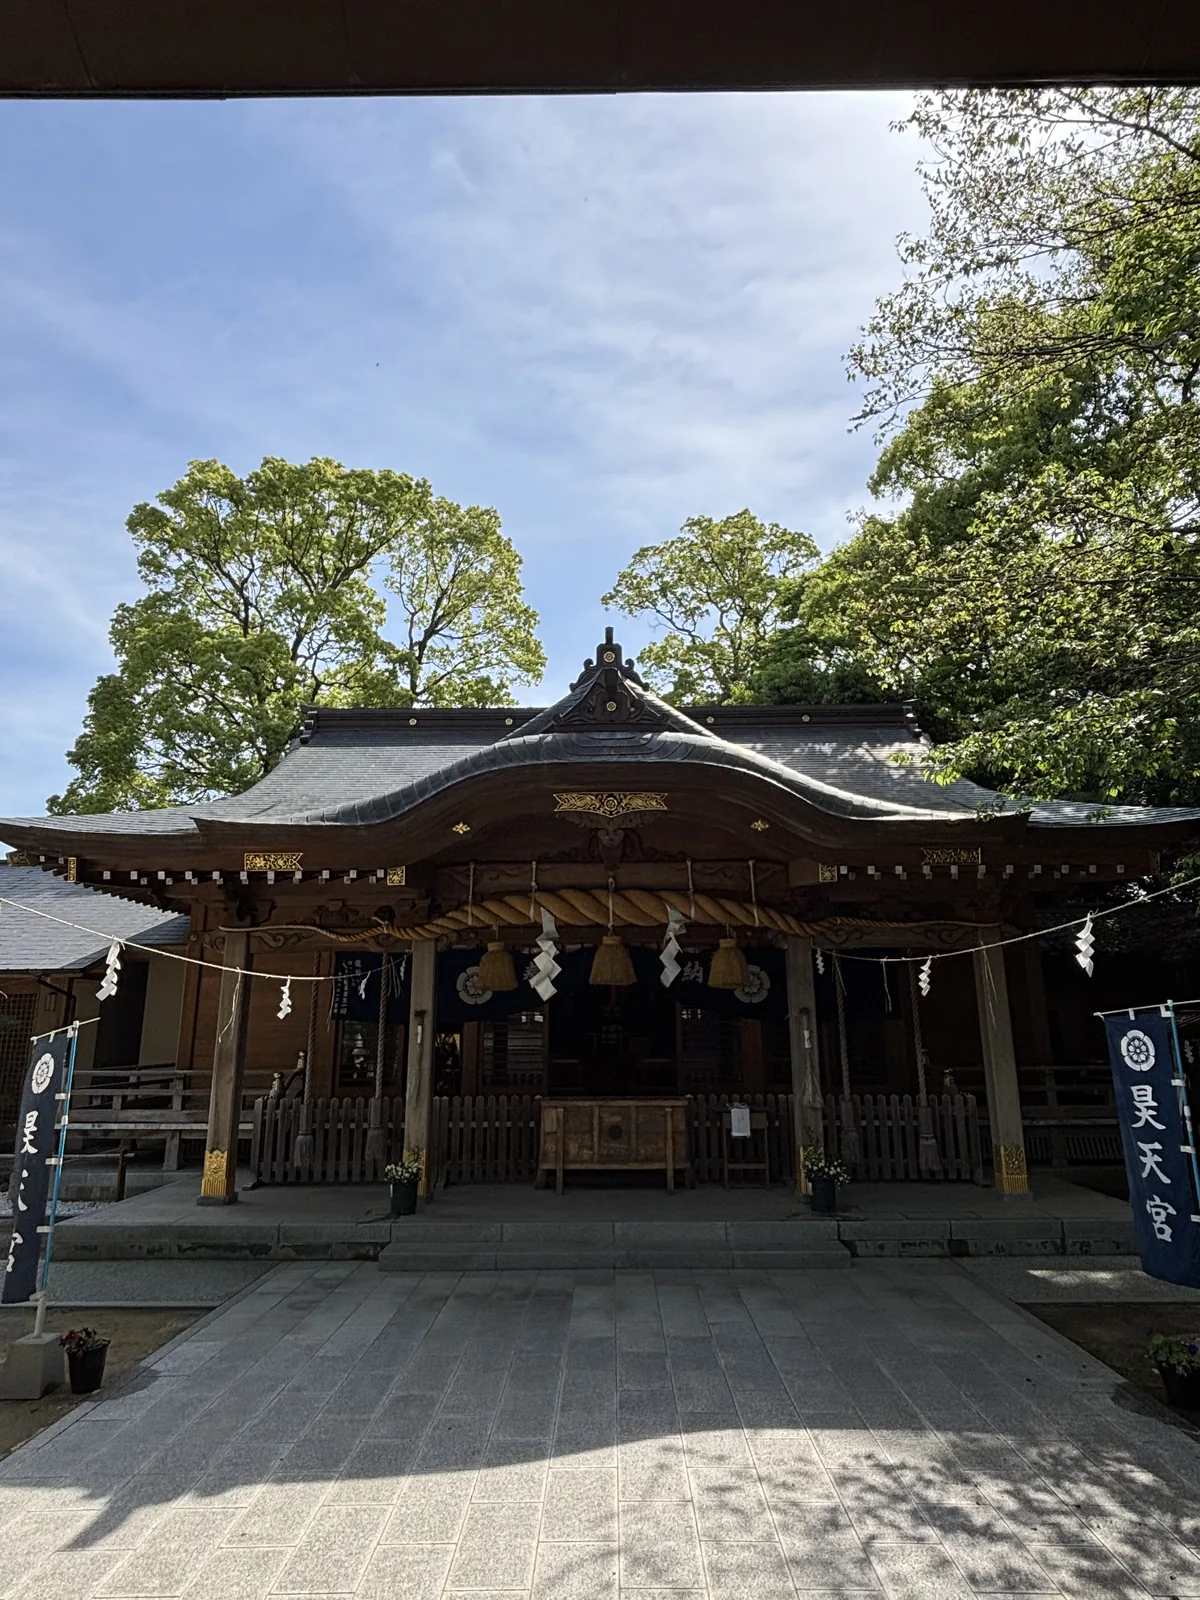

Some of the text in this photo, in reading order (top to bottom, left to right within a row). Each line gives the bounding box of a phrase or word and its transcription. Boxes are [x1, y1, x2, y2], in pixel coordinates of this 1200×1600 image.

[682, 960, 704, 984] 納
[1130, 1084, 1177, 1243] 昊天宮
